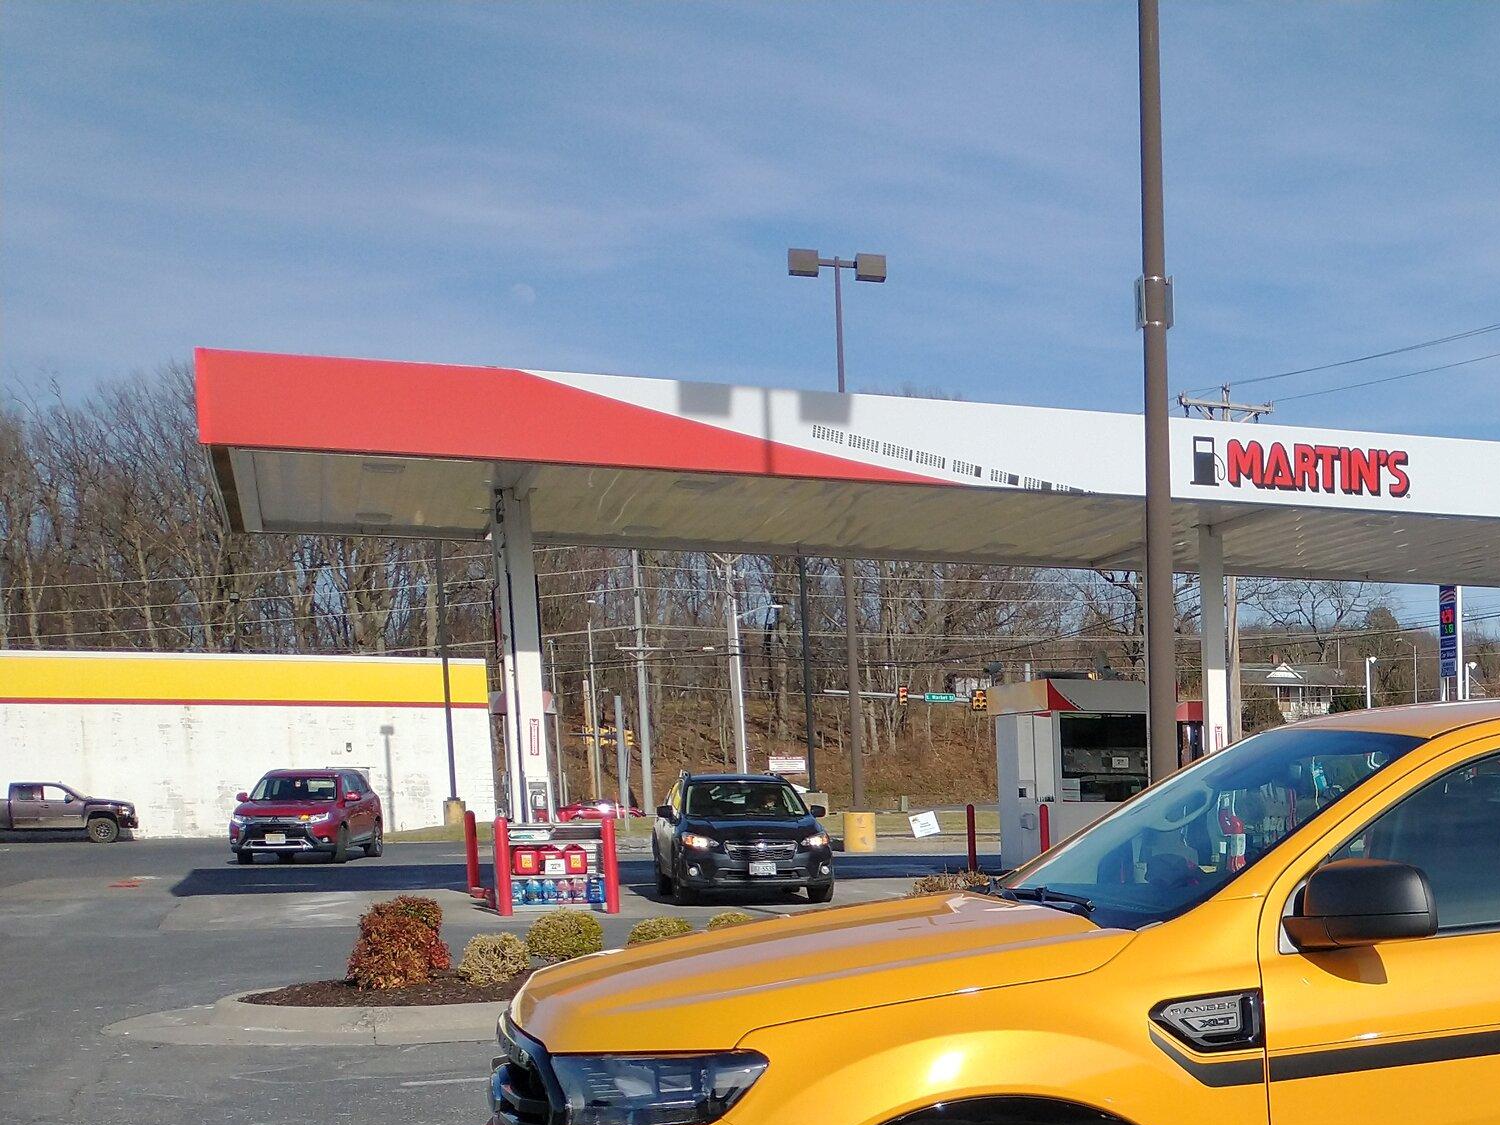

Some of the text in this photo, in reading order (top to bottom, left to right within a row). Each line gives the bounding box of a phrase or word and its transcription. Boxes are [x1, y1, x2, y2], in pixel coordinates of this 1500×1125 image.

[1227, 439, 1410, 498] MARTIN'S
[1170, 1001, 1237, 1016] RANGER
[1200, 1016, 1234, 1028] XLT
